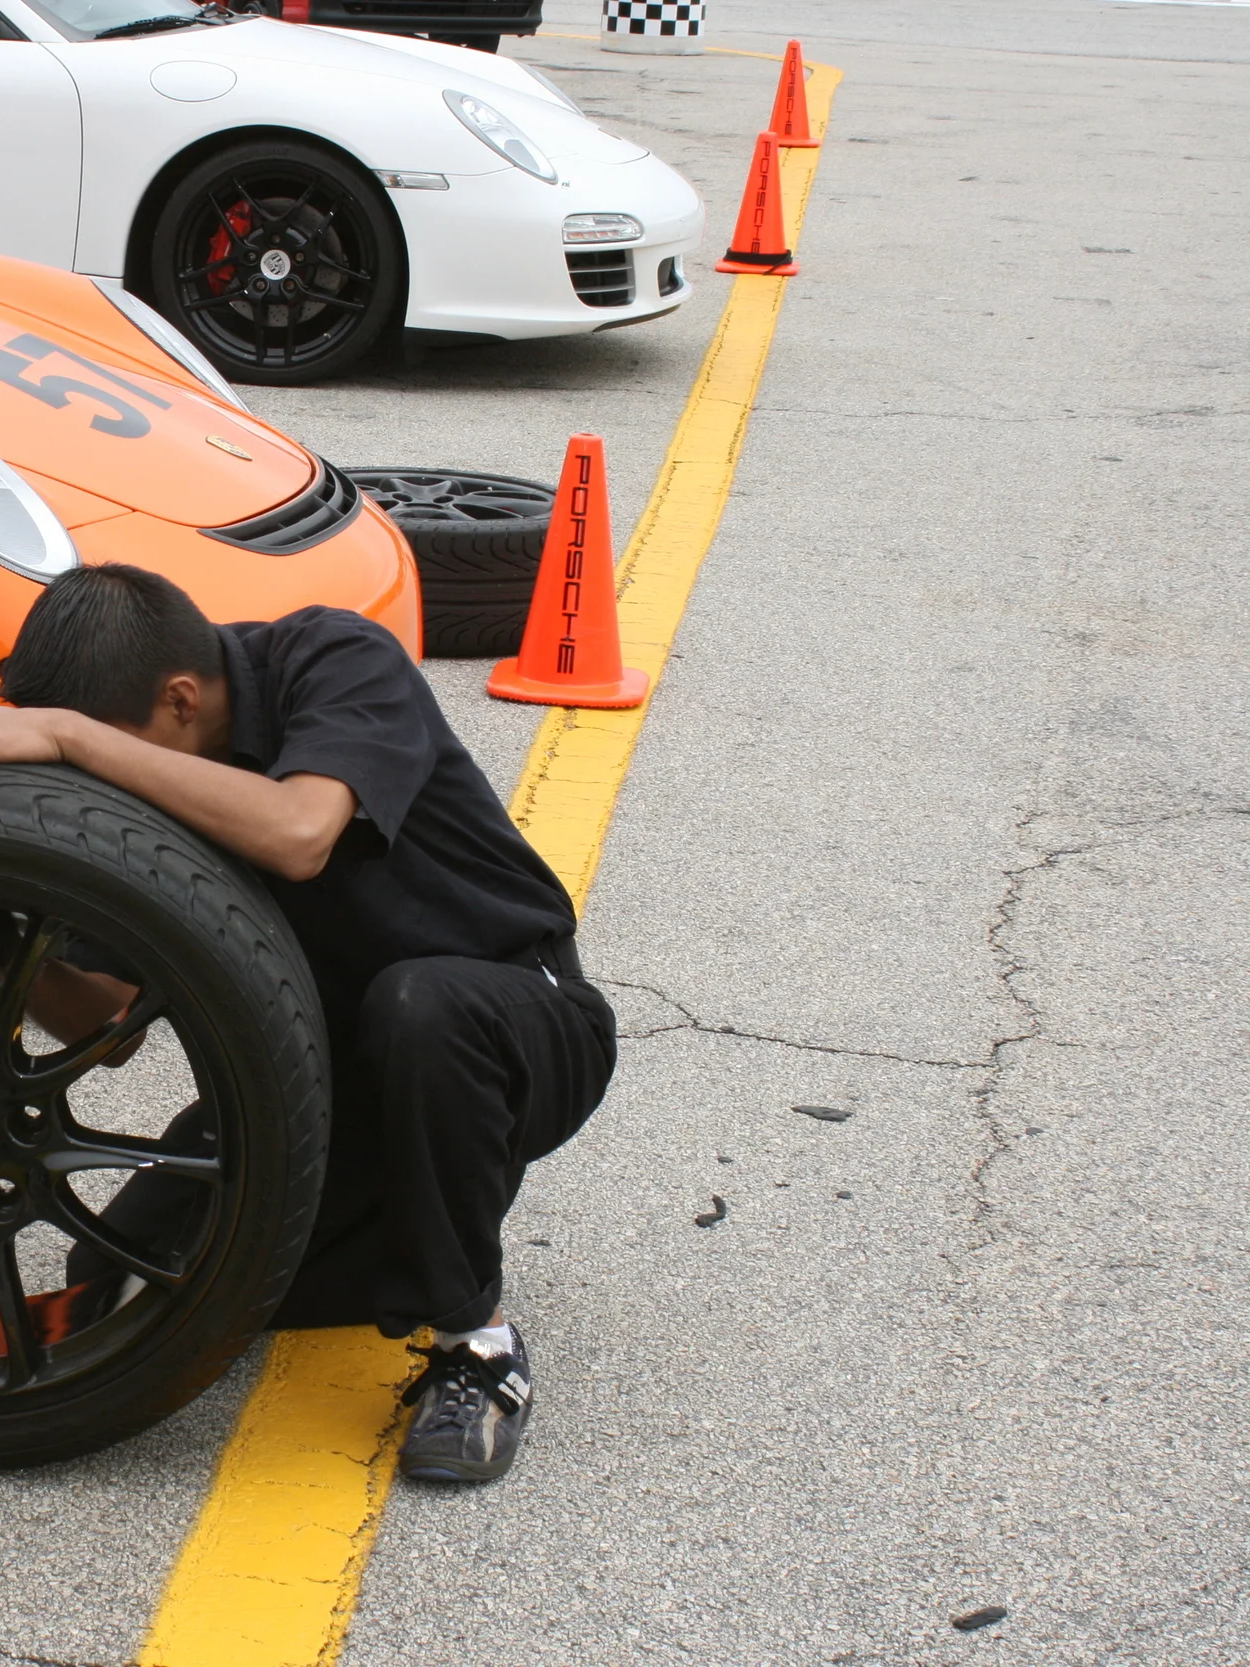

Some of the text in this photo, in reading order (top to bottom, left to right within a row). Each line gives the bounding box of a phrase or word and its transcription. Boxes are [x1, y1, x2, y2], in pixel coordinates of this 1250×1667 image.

[784, 48, 798, 135] PORSCHE
[751, 141, 771, 254] PORSCHE
[557, 455, 591, 674] PORSCHE
